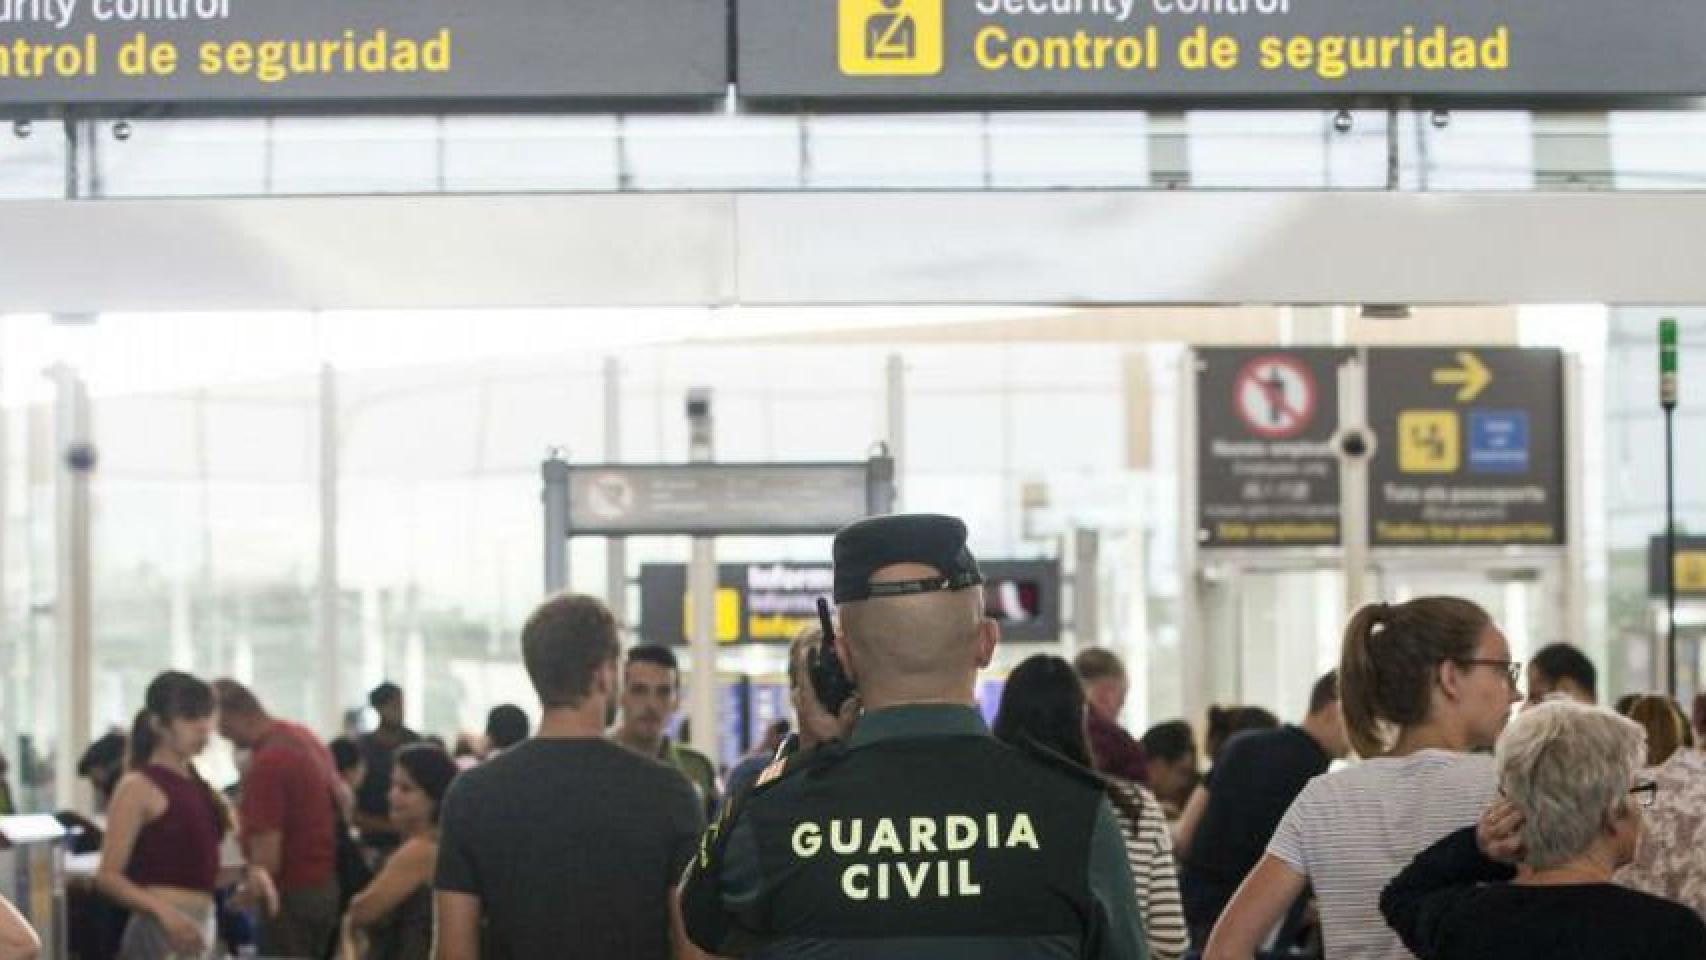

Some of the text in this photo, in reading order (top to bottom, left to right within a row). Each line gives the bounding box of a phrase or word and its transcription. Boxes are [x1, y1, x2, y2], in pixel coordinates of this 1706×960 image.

[92, 0, 229, 21] control
[117, 32, 178, 74] de
[200, 28, 451, 82] seguridad
[974, 25, 1510, 79] Control de seguridad
[791, 813, 1040, 858] GUARDIA
[841, 859, 981, 899] CIVIL
